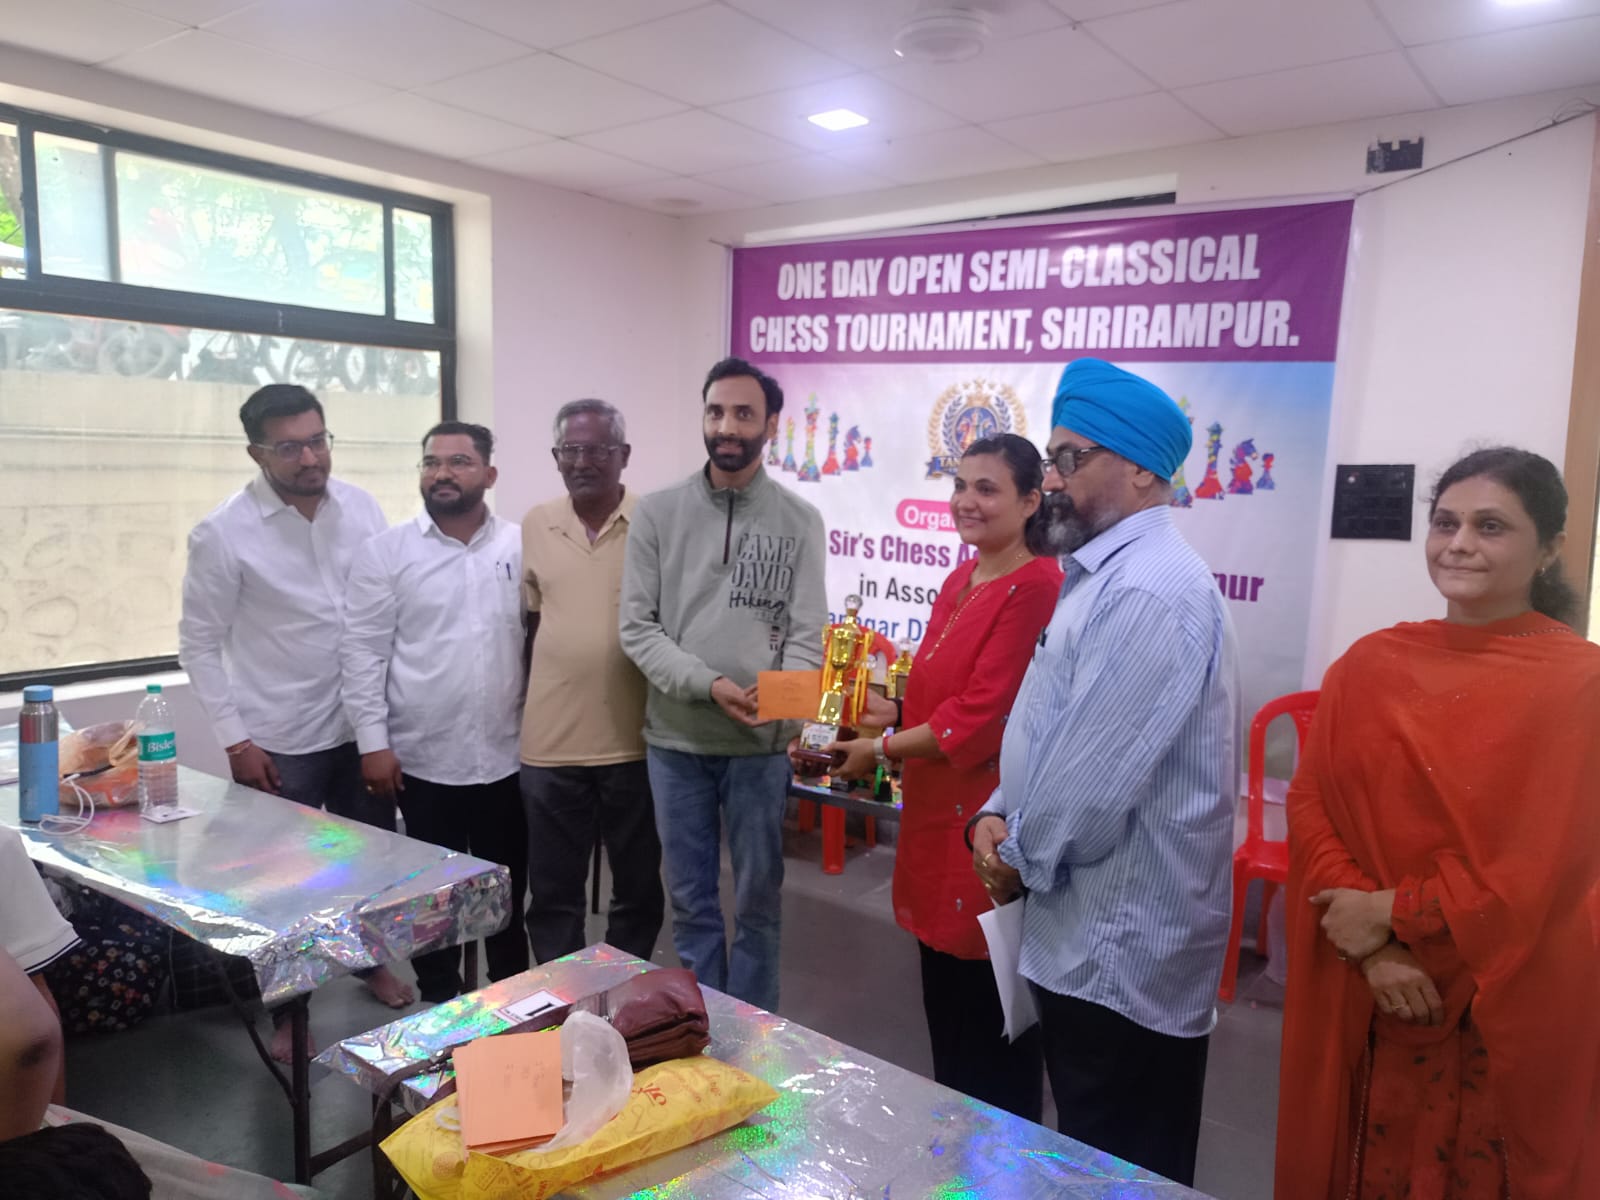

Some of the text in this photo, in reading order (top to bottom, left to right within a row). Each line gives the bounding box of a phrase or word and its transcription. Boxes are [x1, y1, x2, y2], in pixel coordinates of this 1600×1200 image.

[777, 234, 1261, 300] ONE DAY OPEN SEMI-CLASSICAL
[750, 300, 1300, 354] CHESS TOURNAMENT, SHRIRAMPUR.
[737, 532, 796, 564] CAMP
[829, 530, 875, 559] Sir's
[880, 534, 951, 568] Chess
[731, 561, 793, 593] DAVID
[859, 572, 878, 598] in
[729, 590, 785, 621] Hiking
